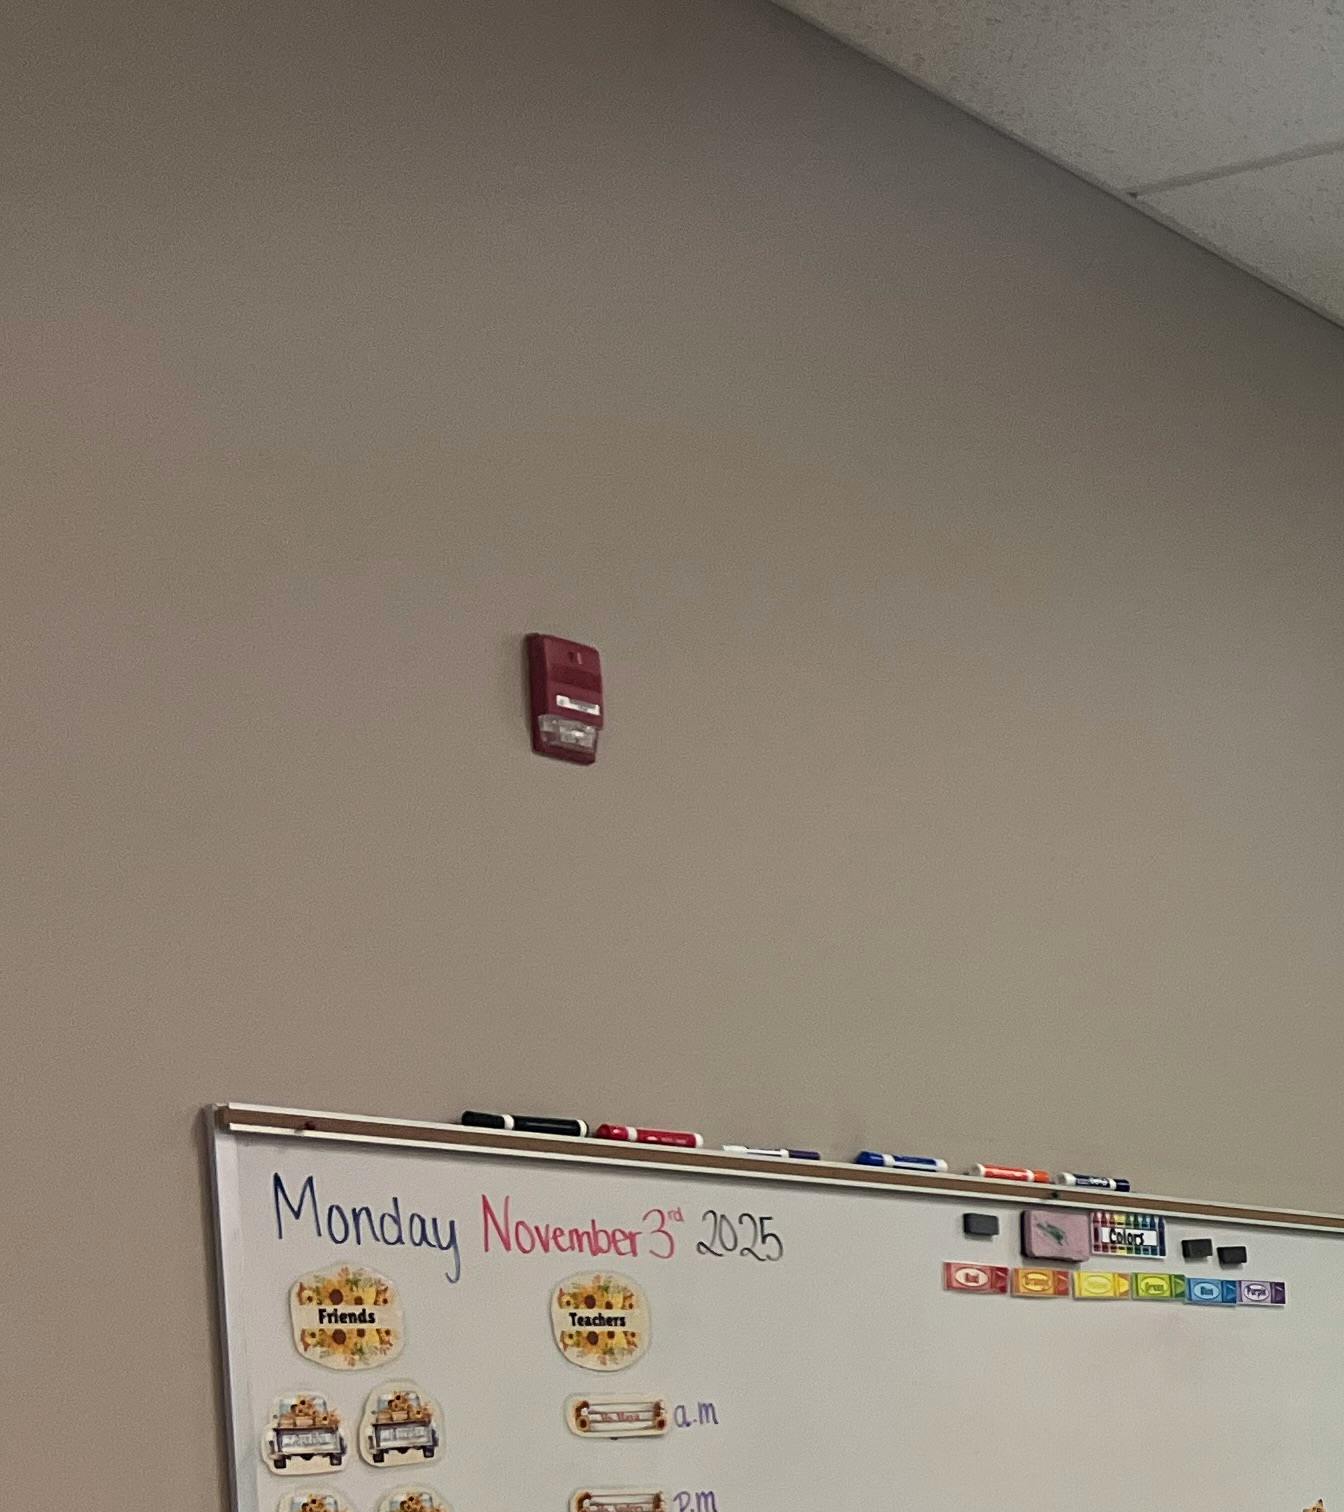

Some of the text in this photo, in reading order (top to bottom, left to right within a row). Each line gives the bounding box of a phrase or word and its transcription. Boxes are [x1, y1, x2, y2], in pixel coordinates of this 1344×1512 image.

[272, 1171, 784, 1284] Monday November 3rd 2025
[1109, 1227, 1145, 1246] Colors
[318, 1308, 376, 1325] Friends
[568, 1311, 627, 1327] Teachers
[673, 1401, 719, 1428] a.m
